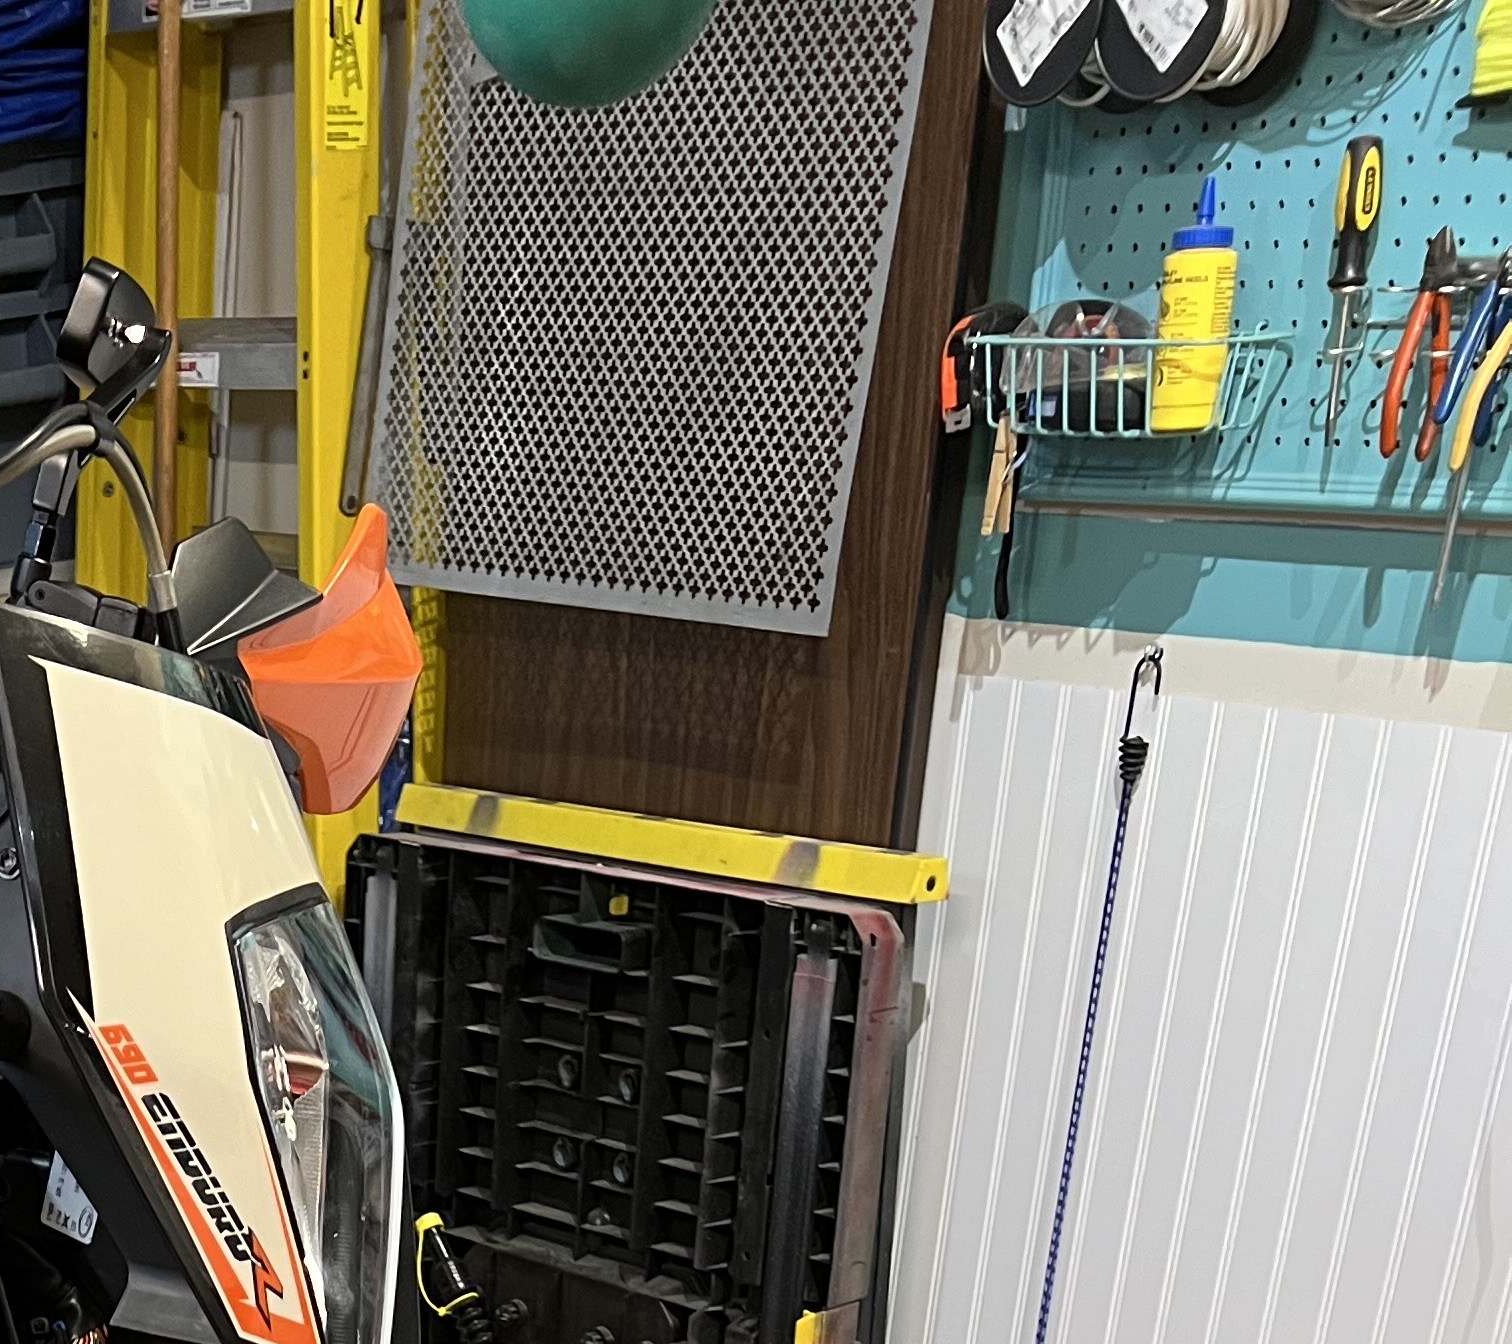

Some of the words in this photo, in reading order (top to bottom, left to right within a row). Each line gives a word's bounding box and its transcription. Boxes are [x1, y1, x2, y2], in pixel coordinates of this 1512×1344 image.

[99, 1023, 159, 1086] 690
[141, 1092, 252, 1262] ENDURO
[246, 1226, 284, 1332] R
